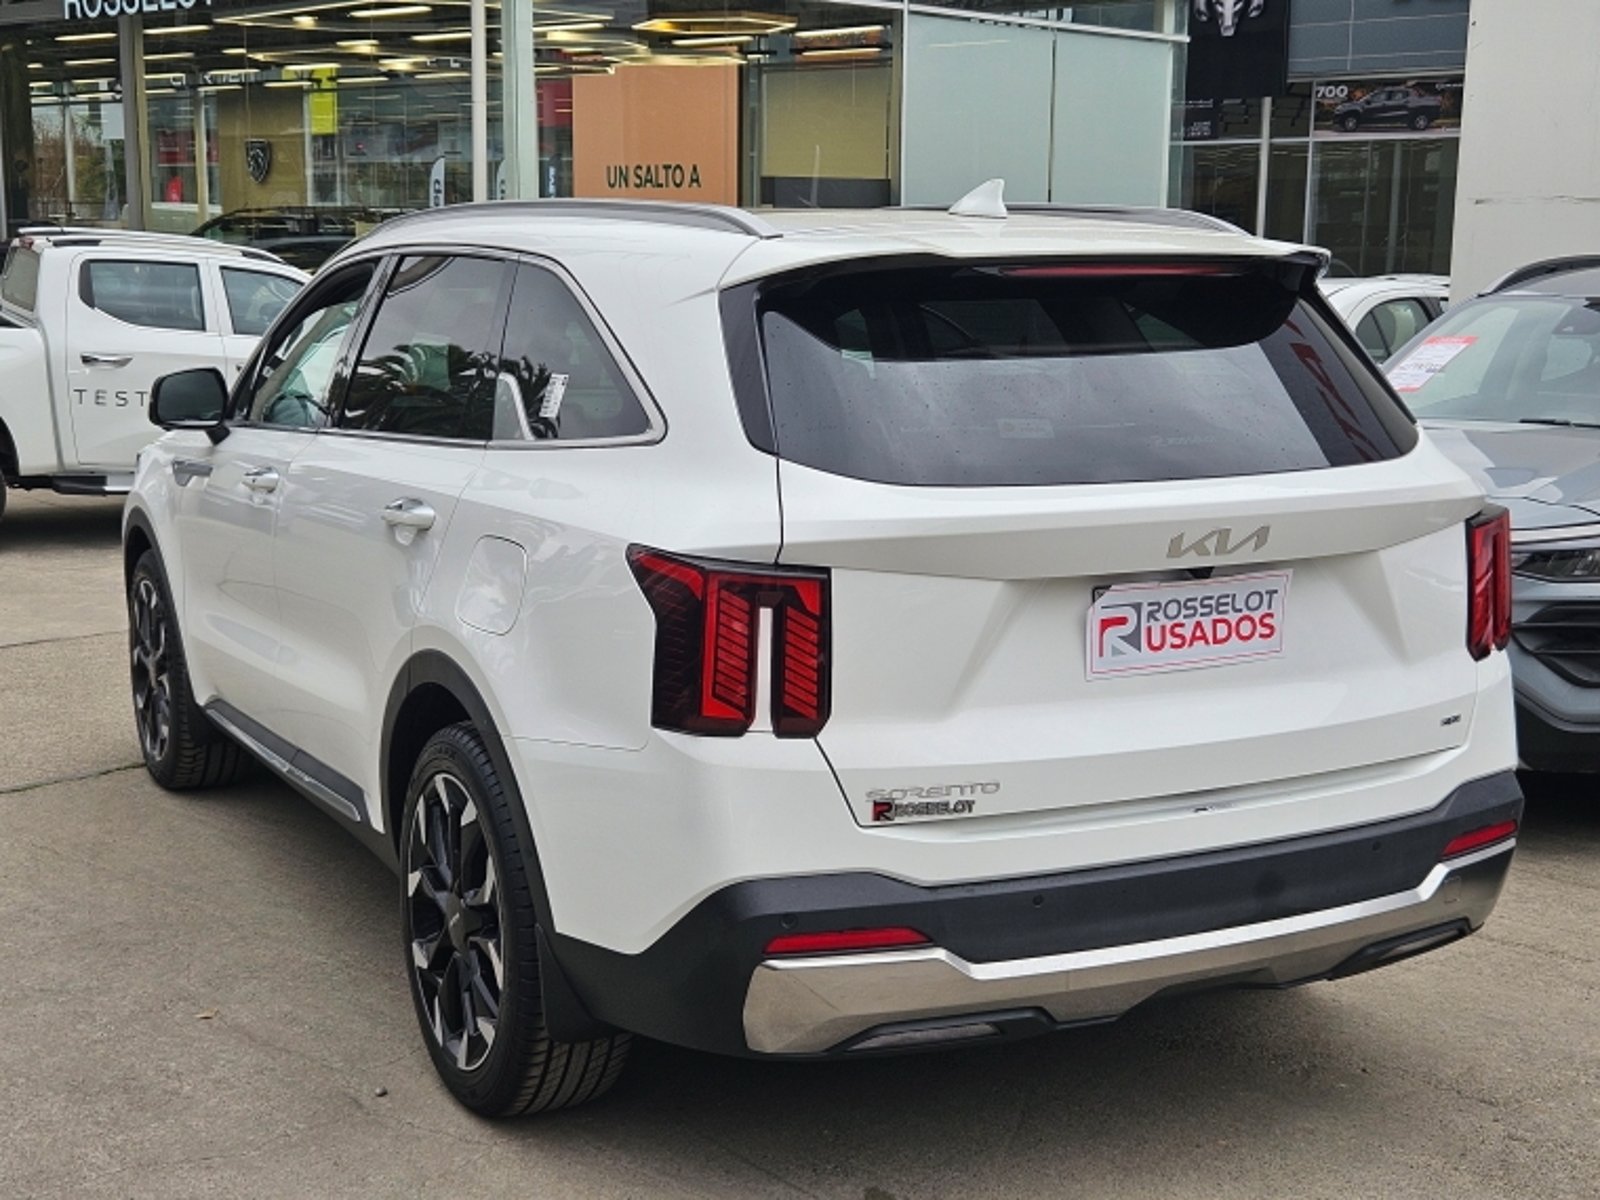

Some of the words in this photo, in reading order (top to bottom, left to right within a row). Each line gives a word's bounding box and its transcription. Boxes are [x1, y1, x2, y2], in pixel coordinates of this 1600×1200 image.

[64, 0, 212, 19] ROSSE
[1315, 85, 1349, 98] 700
[606, 165, 629, 188] UN
[633, 164, 685, 188] SALTO
[688, 164, 702, 188] A
[73, 388, 148, 407] TEST
[1147, 589, 1279, 622] ROSSELOT
[1146, 612, 1276, 652] USADOS
